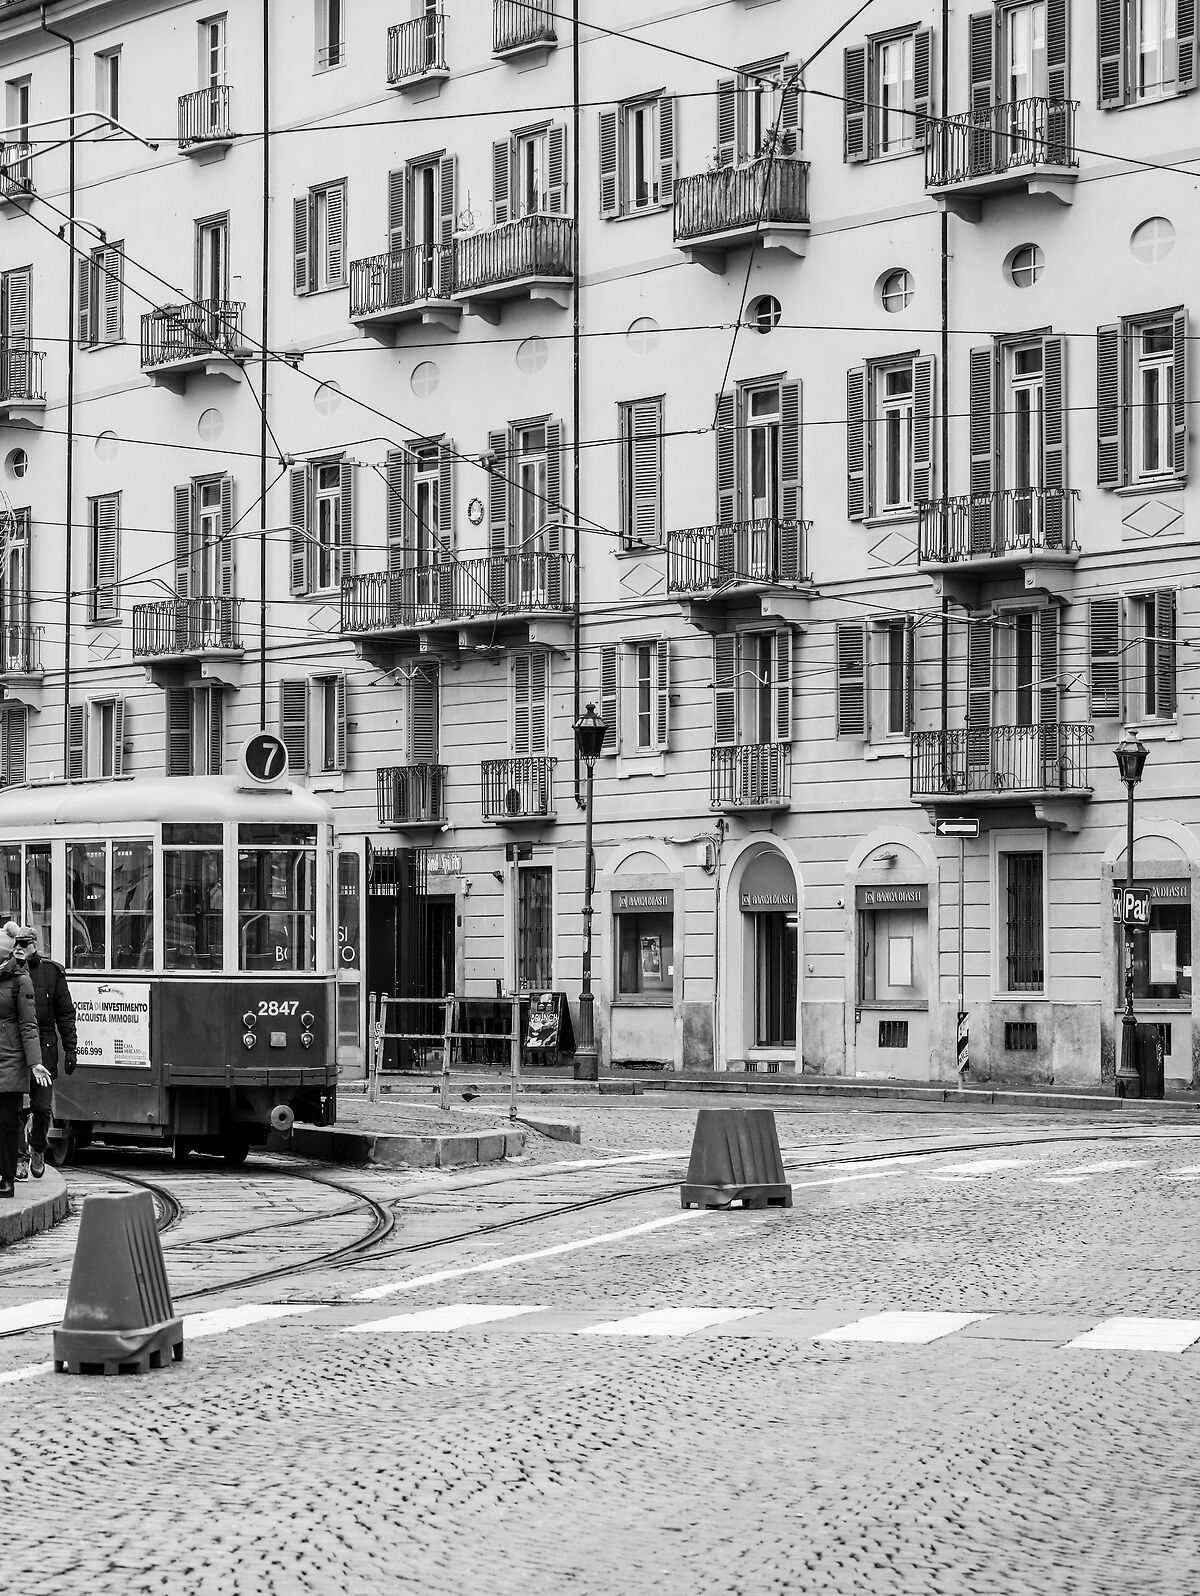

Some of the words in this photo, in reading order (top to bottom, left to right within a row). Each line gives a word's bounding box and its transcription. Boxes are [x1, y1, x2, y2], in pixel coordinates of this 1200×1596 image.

[262, 742, 278, 776] 7
[73, 1000, 93, 1011] OCIETÀ
[102, 1002, 148, 1012] INVESTIMENTO
[258, 1001, 300, 1016] 2847
[77, 1013, 107, 1022] ACQUISTA
[109, 1014, 139, 1023] IMMOBILI
